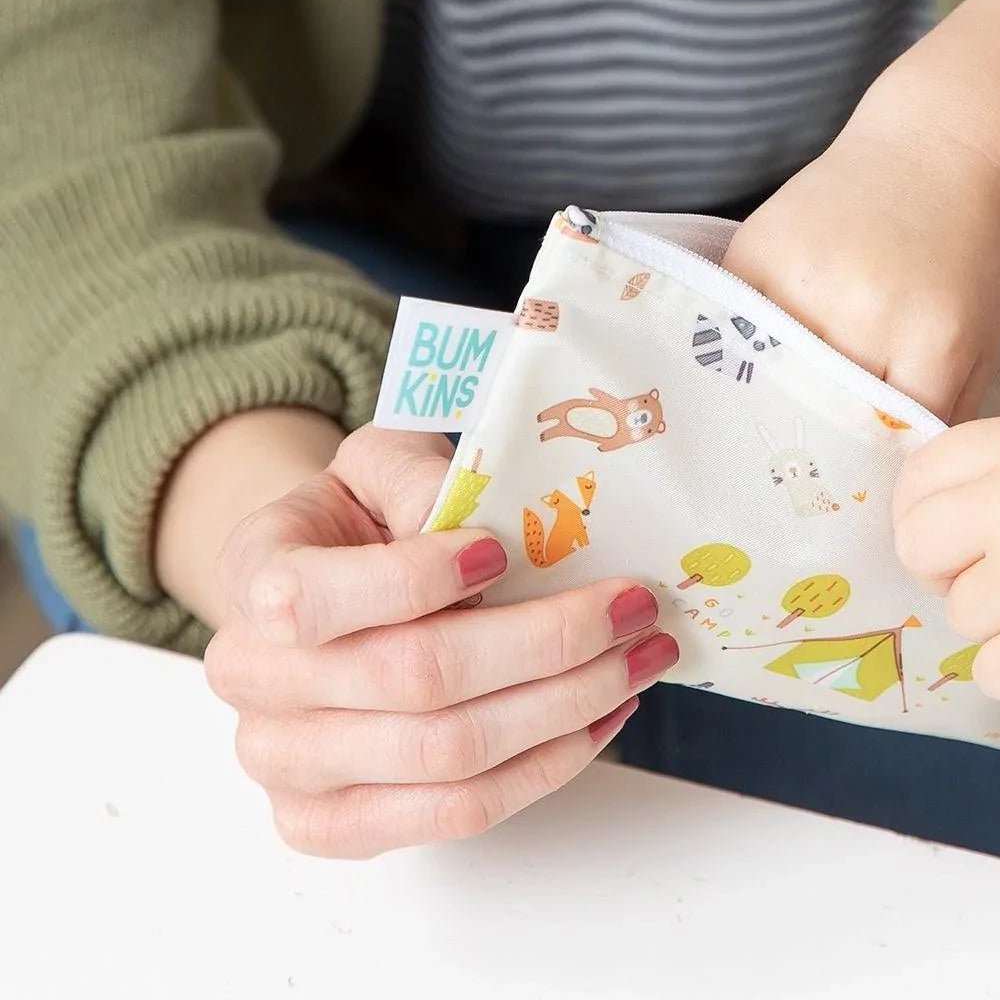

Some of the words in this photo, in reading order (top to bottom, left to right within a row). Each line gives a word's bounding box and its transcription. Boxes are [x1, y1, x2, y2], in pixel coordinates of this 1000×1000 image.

[408, 322, 497, 372] BUM
[672, 598, 731, 638] CAMP
[704, 598, 734, 617] GO
